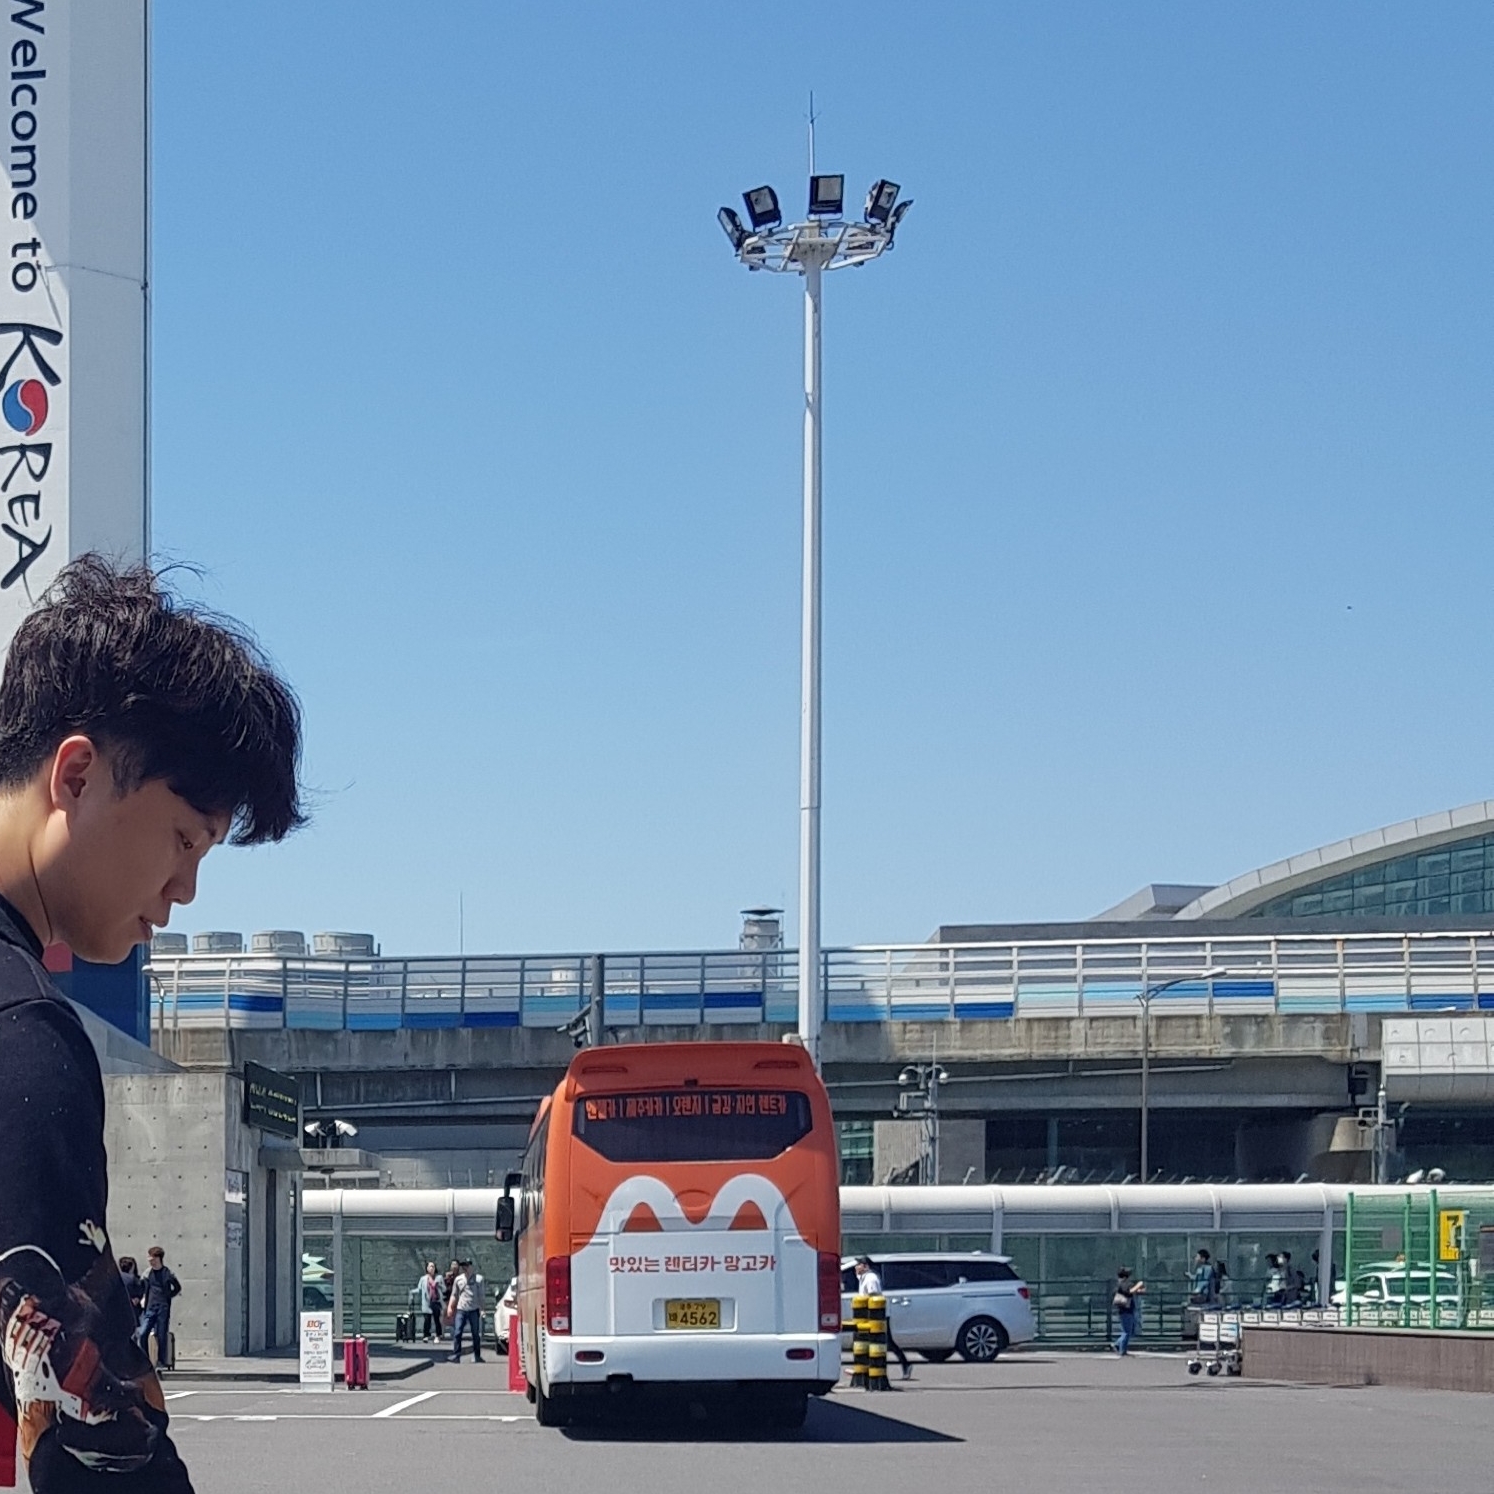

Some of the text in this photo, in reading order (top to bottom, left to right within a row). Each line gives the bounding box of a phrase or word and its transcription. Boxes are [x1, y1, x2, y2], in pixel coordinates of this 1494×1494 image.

[10, 0, 47, 294] Welcome to
[609, 1254, 777, 1274] 맛있는 렌터카 망고카
[680, 1311, 717, 1326] 4562
